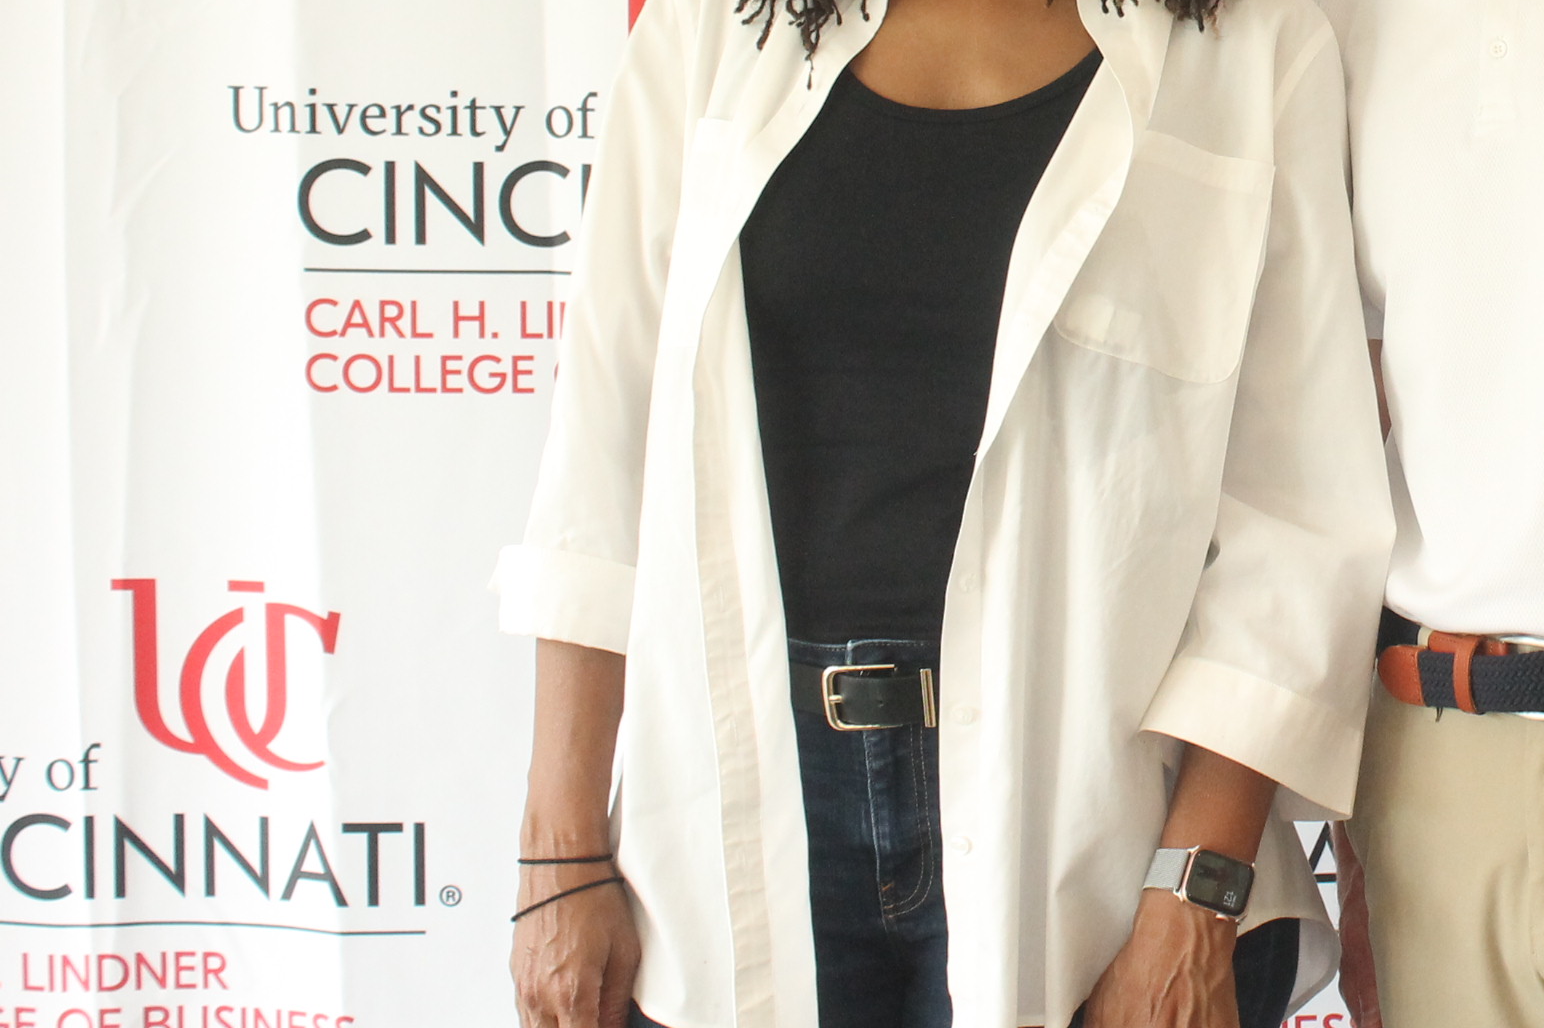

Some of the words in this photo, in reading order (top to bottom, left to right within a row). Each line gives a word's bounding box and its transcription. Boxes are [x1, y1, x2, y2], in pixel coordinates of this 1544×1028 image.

[228, 85, 525, 152] University
[545, 91, 598, 139] of
[305, 298, 434, 339] CARL
[453, 300, 499, 339] H.
[305, 353, 535, 394] COLLEGE
[46, 743, 100, 791] of
[22, 951, 229, 992] LINDNER
